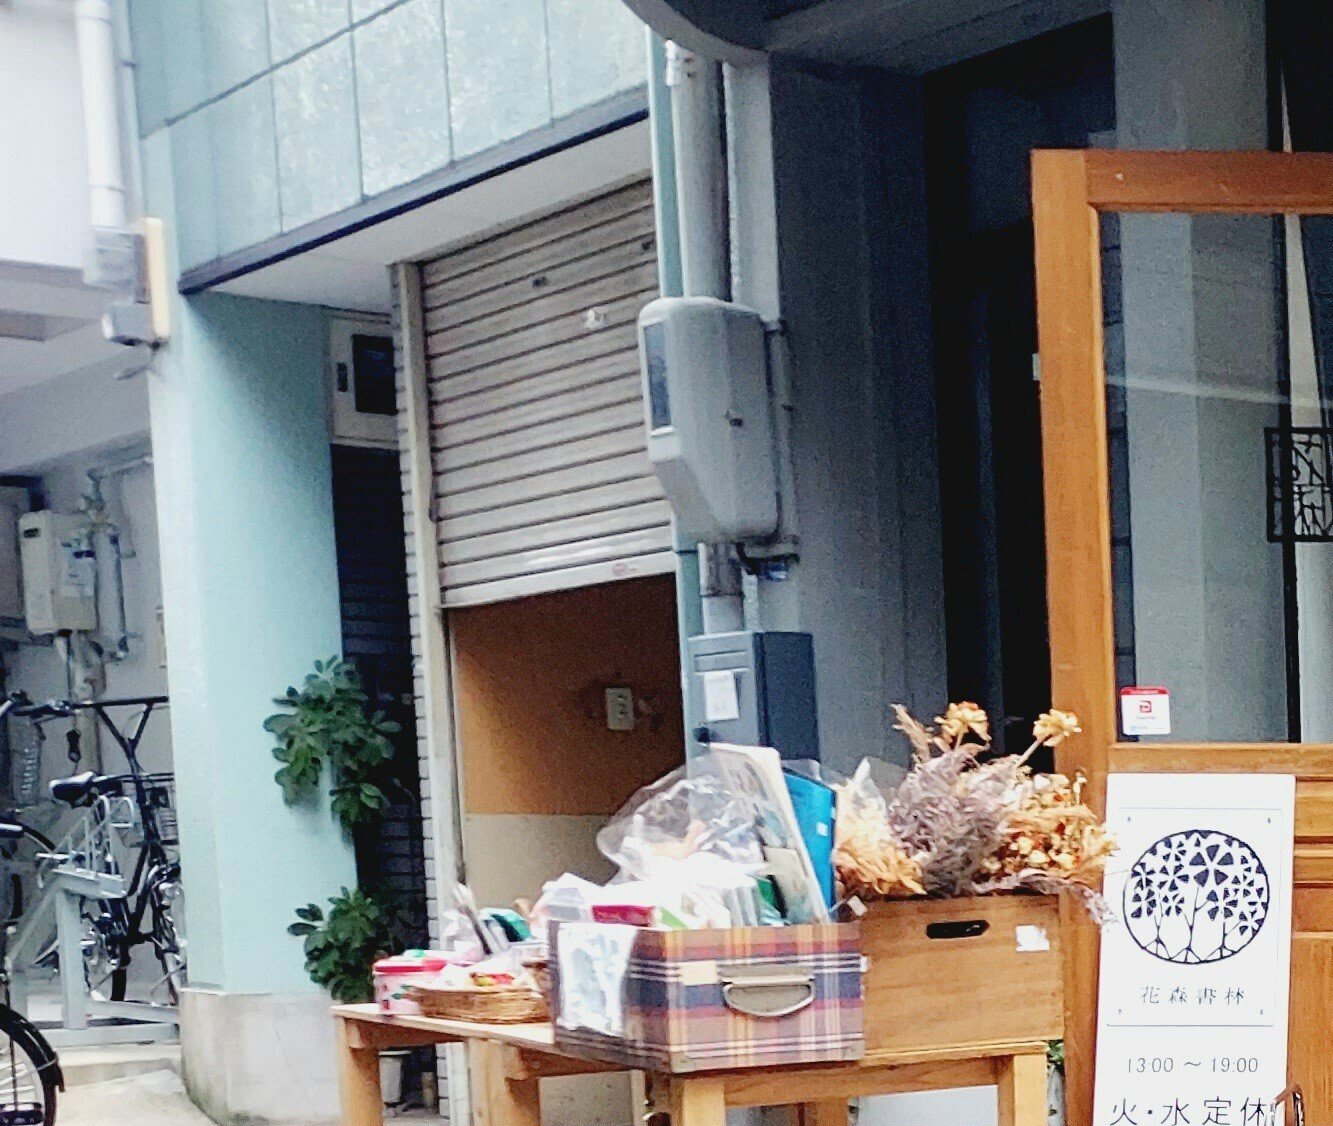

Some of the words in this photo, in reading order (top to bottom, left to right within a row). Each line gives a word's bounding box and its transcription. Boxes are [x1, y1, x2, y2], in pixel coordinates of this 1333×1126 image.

[1140, 985, 1245, 1006] 花森書林
[1212, 1057, 1259, 1073] 19:00
